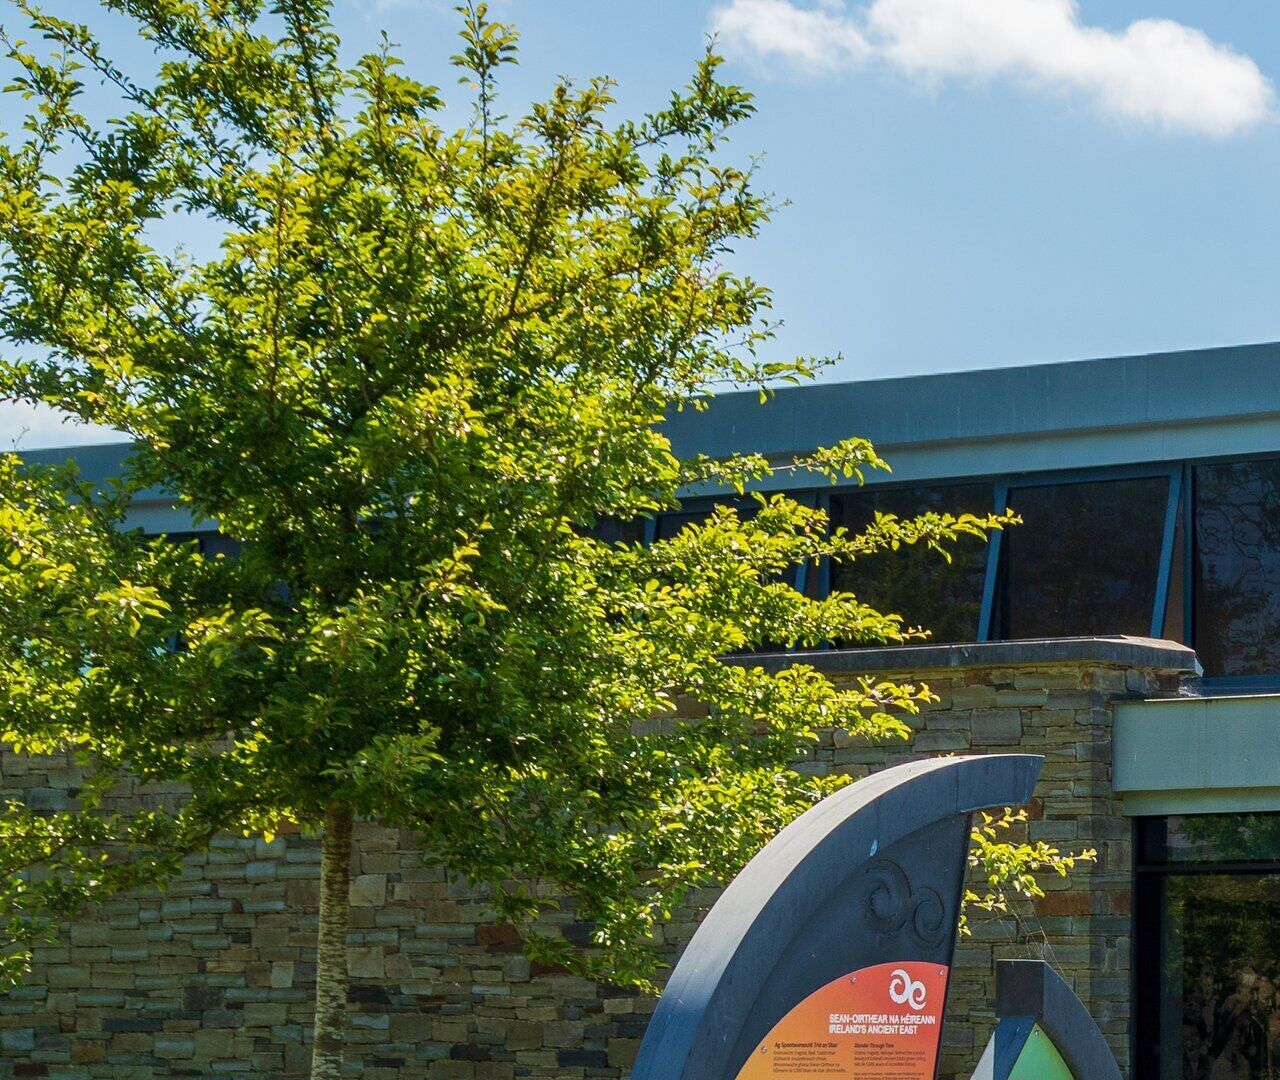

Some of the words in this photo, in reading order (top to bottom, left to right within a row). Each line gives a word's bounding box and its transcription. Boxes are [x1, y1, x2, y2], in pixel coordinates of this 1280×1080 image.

[829, 1014, 888, 1024] SEAN-OIRTHEAR
[889, 1014, 899, 1024] NA
[829, 1025, 867, 1034] IRELAND'S
[868, 1025, 898, 1034] ANCIENT
[899, 1025, 918, 1034] EAST
